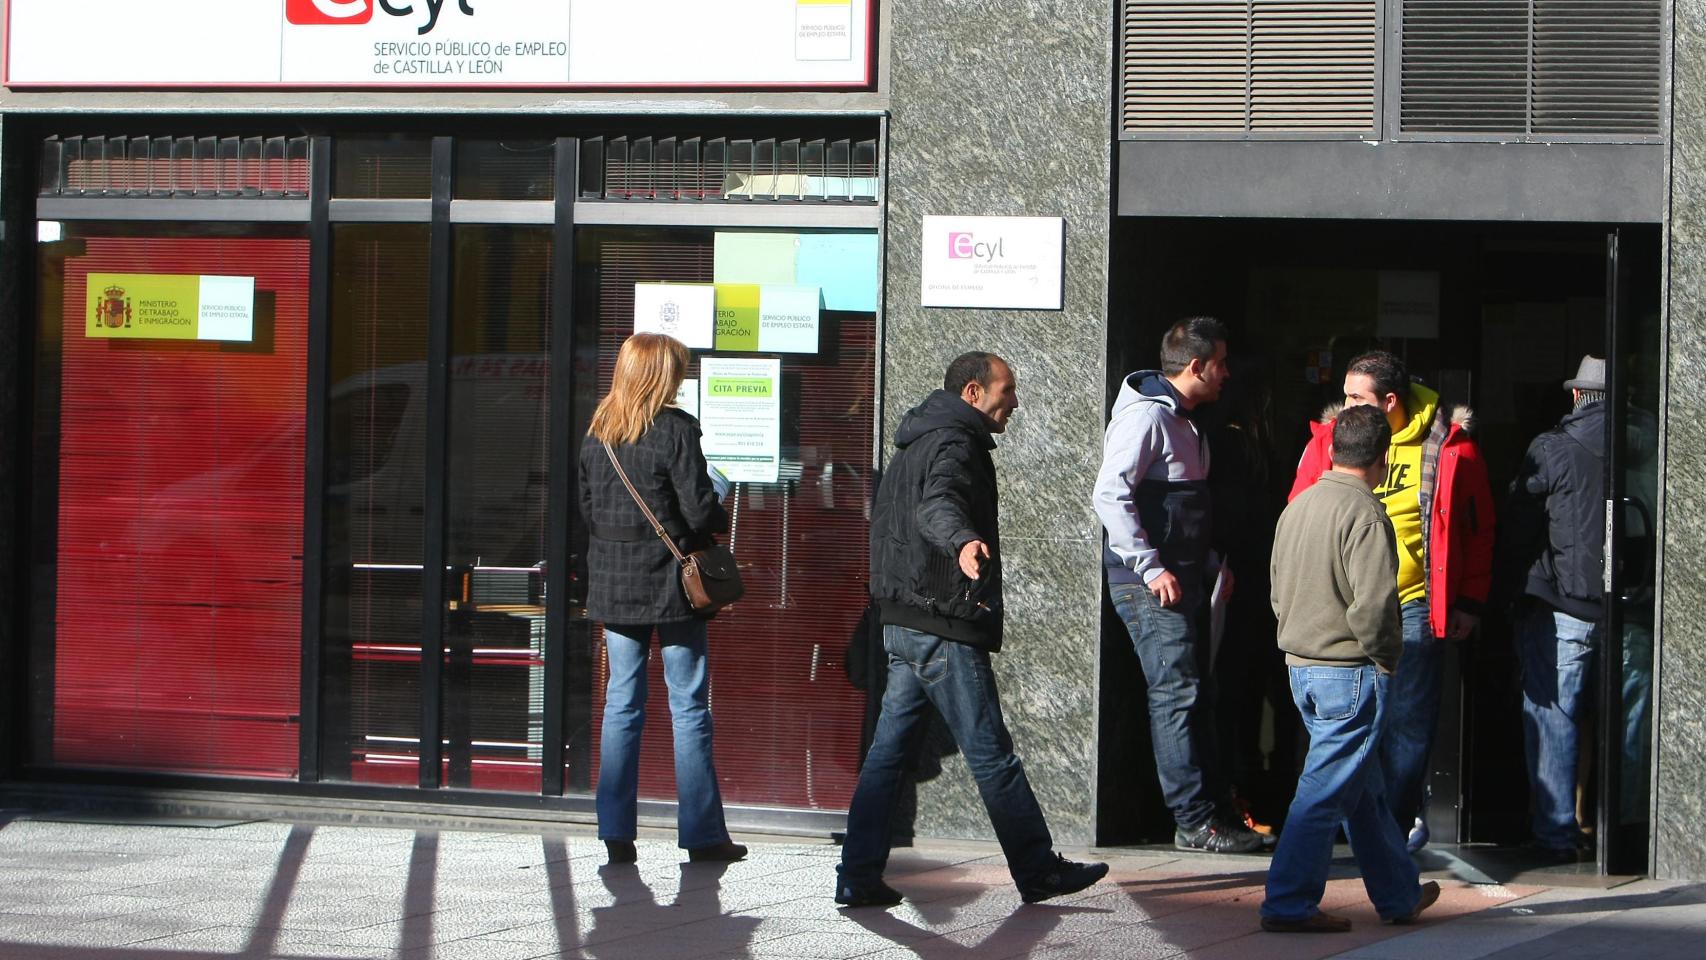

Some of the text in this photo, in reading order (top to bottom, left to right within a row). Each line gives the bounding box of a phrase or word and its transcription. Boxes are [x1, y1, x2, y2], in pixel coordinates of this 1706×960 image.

[374, 39, 567, 56] SERVICIO PÚBLICO de EMPLEO
[373, 56, 503, 74] de CASTILLA Y LEÓN
[139, 300, 177, 308] MINISTERIO
[139, 308, 179, 317] DE TRABAJO
[714, 310, 736, 318] TERIO
[139, 317, 143, 325] E
[714, 319, 738, 328] ABAJO
[713, 385, 768, 393] CITA PREVIA
[1382, 463, 1411, 488] KE
